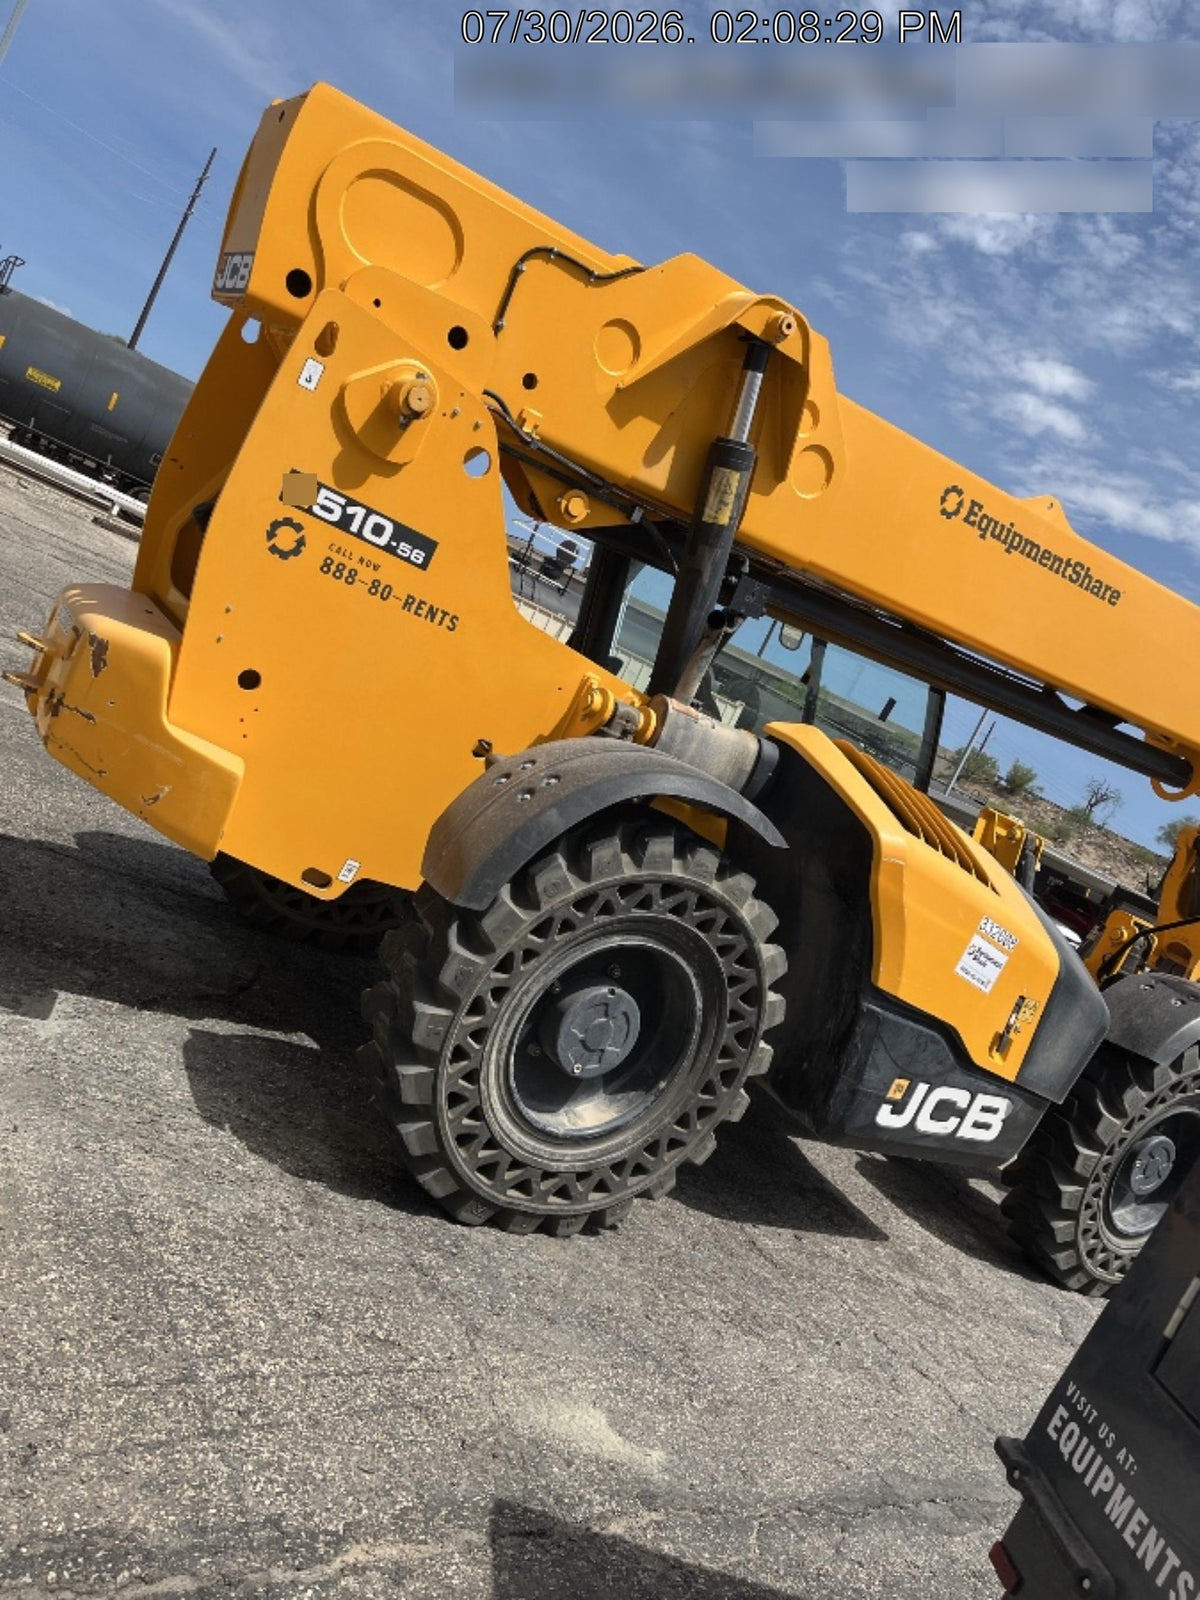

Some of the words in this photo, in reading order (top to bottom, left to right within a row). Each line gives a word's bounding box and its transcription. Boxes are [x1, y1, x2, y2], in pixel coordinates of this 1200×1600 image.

[215, 254, 253, 289] JCB
[328, 542, 353, 561] CALL
[357, 556, 381, 572] NOW
[963, 499, 1121, 607] EquipmentShare
[319, 556, 460, 632] 888-80-RENTS
[875, 1082, 1014, 1142] JCB
[1066, 1381, 1098, 1424] VISIT
[1098, 1422, 1116, 1448] US
[1116, 1447, 1138, 1476] AT:
[1047, 1404, 1200, 1600] EQUIPMENTS
